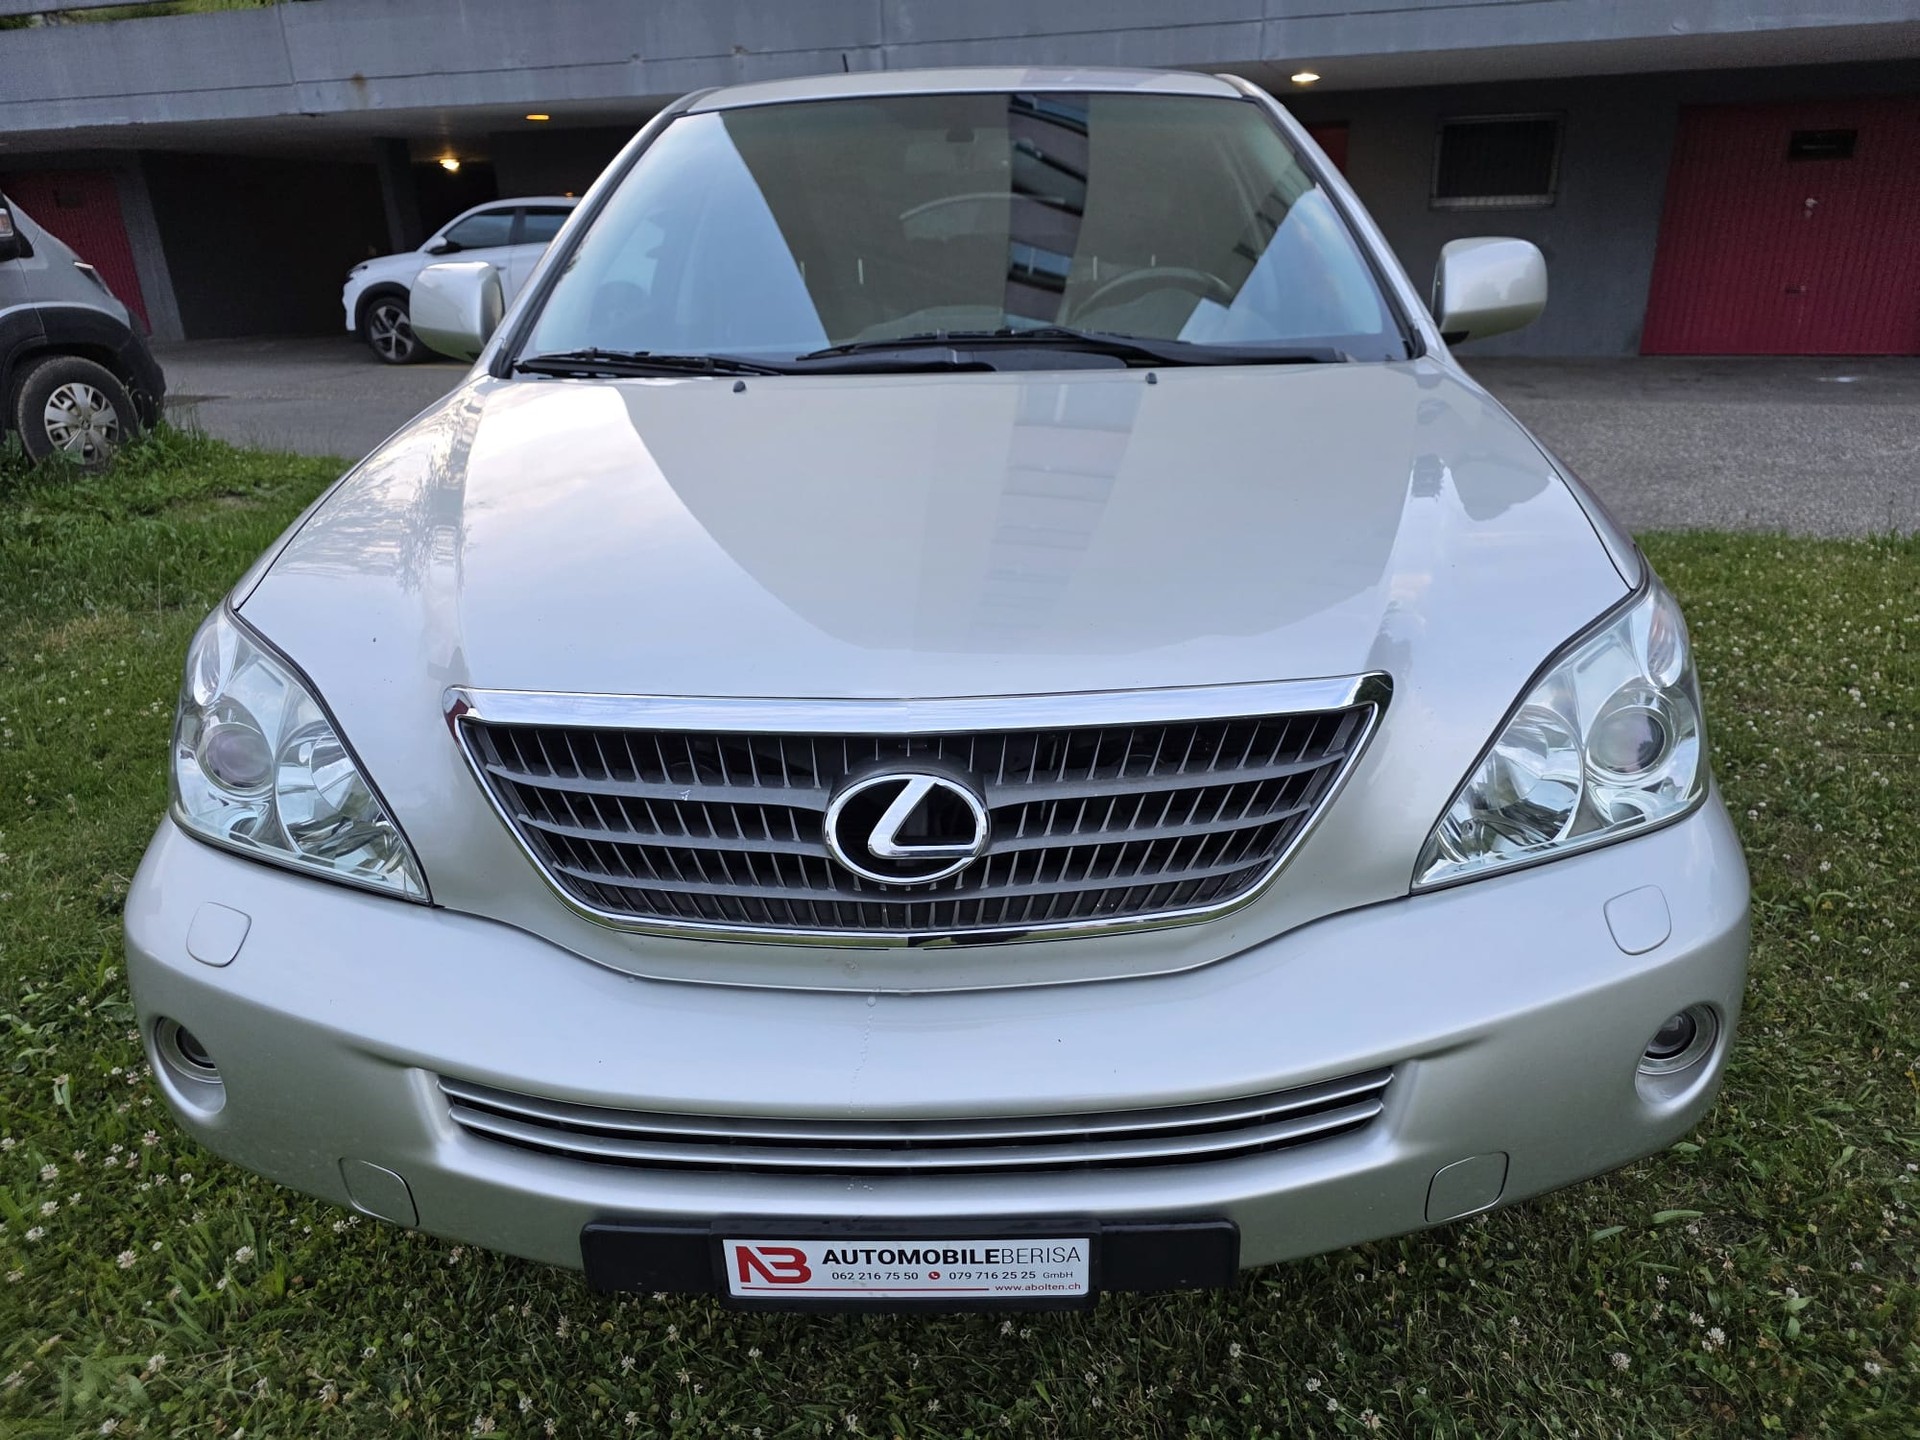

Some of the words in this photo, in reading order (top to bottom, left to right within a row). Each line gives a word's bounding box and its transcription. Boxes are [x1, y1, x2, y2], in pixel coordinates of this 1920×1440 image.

[831, 1271, 855, 1281] 062
[858, 1271, 881, 1281] 216
[884, 1271, 900, 1281] 75
[903, 1271, 919, 1281] 50
[949, 1271, 972, 1280] 079
[976, 1271, 999, 1280] 716
[1002, 1271, 1018, 1280] 25
[1021, 1271, 1036, 1280] 25
[1042, 1271, 1074, 1279] GmbH
[994, 1282, 1081, 1291] www.abolten.ch
